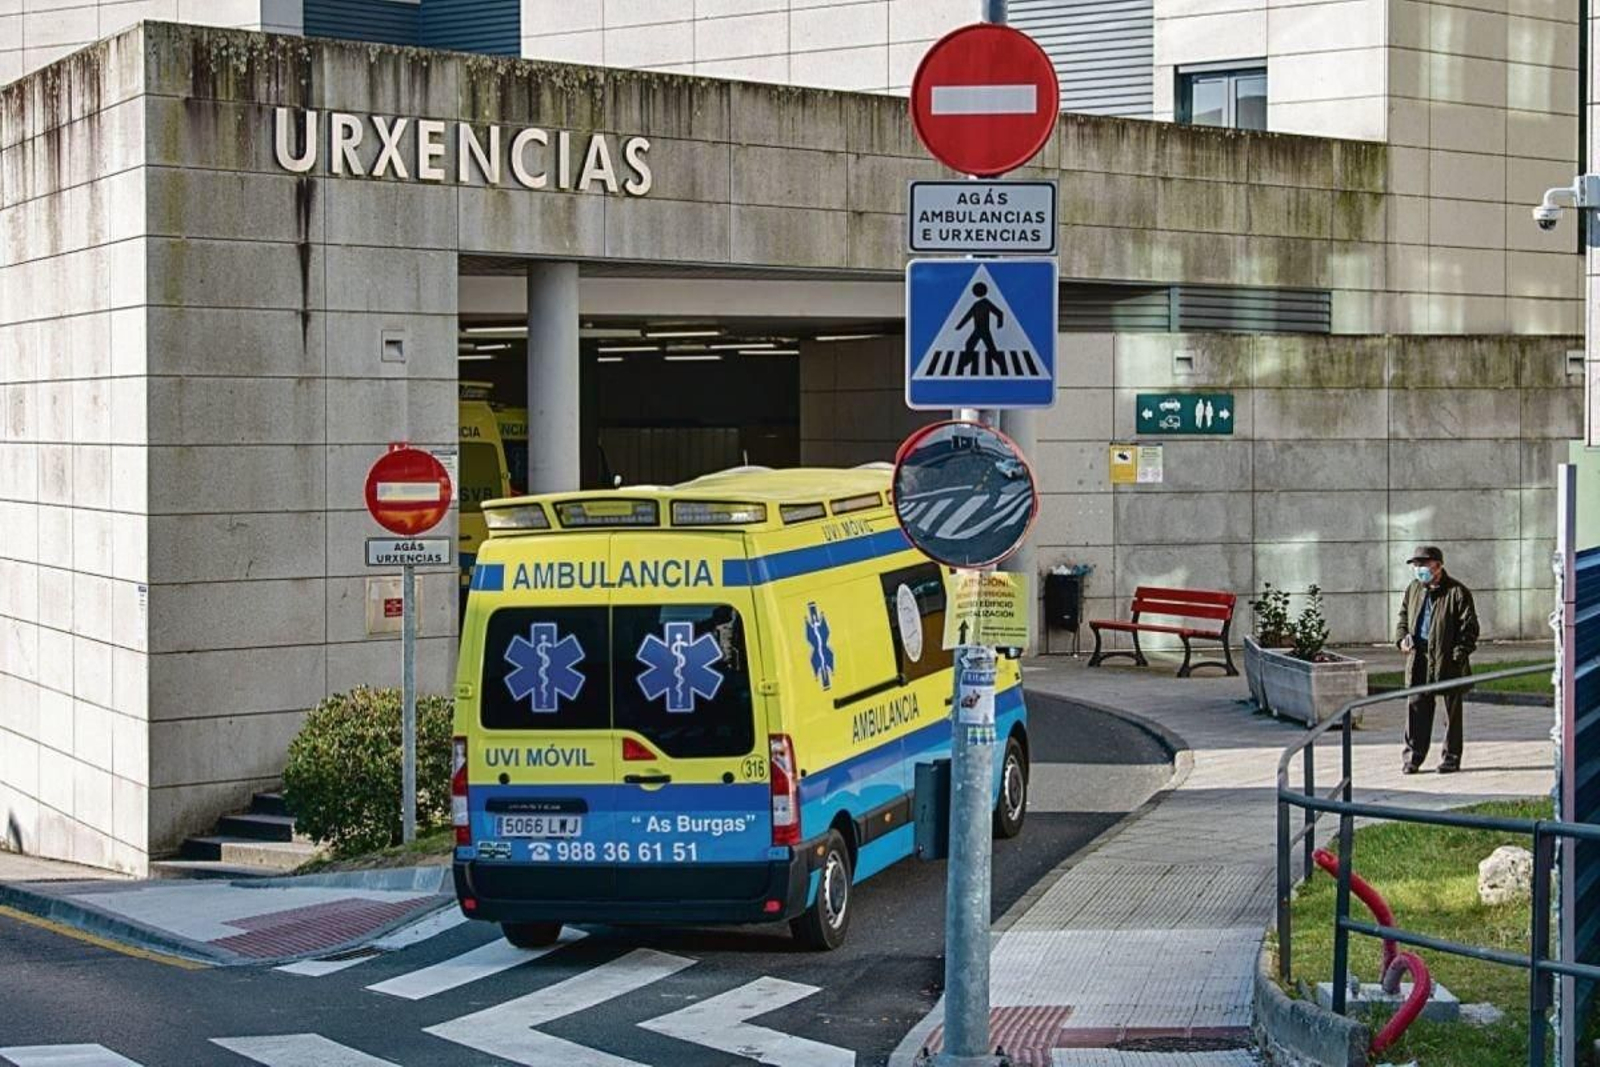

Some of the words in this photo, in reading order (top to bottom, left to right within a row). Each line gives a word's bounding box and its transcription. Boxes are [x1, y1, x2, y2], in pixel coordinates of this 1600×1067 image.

[274, 106, 653, 197] URXENCIAS
[956, 187, 1008, 205] AGÁS
[919, 210, 1046, 224] AMBULANCIAS
[922, 228, 932, 241] E
[939, 228, 1041, 242] URXENCIAS
[394, 541, 425, 552] AGÁS
[376, 554, 442, 564] URXENCIAS
[512, 559, 714, 590] AMBULANCIA
[852, 692, 920, 744] AMBULANCIA
[485, 747, 519, 767] UVI
[526, 744, 595, 767] MÓVIL
[745, 759, 765, 779] 316
[505, 818, 544, 834] 5066
[557, 842, 597, 861] 988
[603, 842, 630, 861] 36
[638, 842, 662, 861] 61
[672, 842, 698, 861] 51
